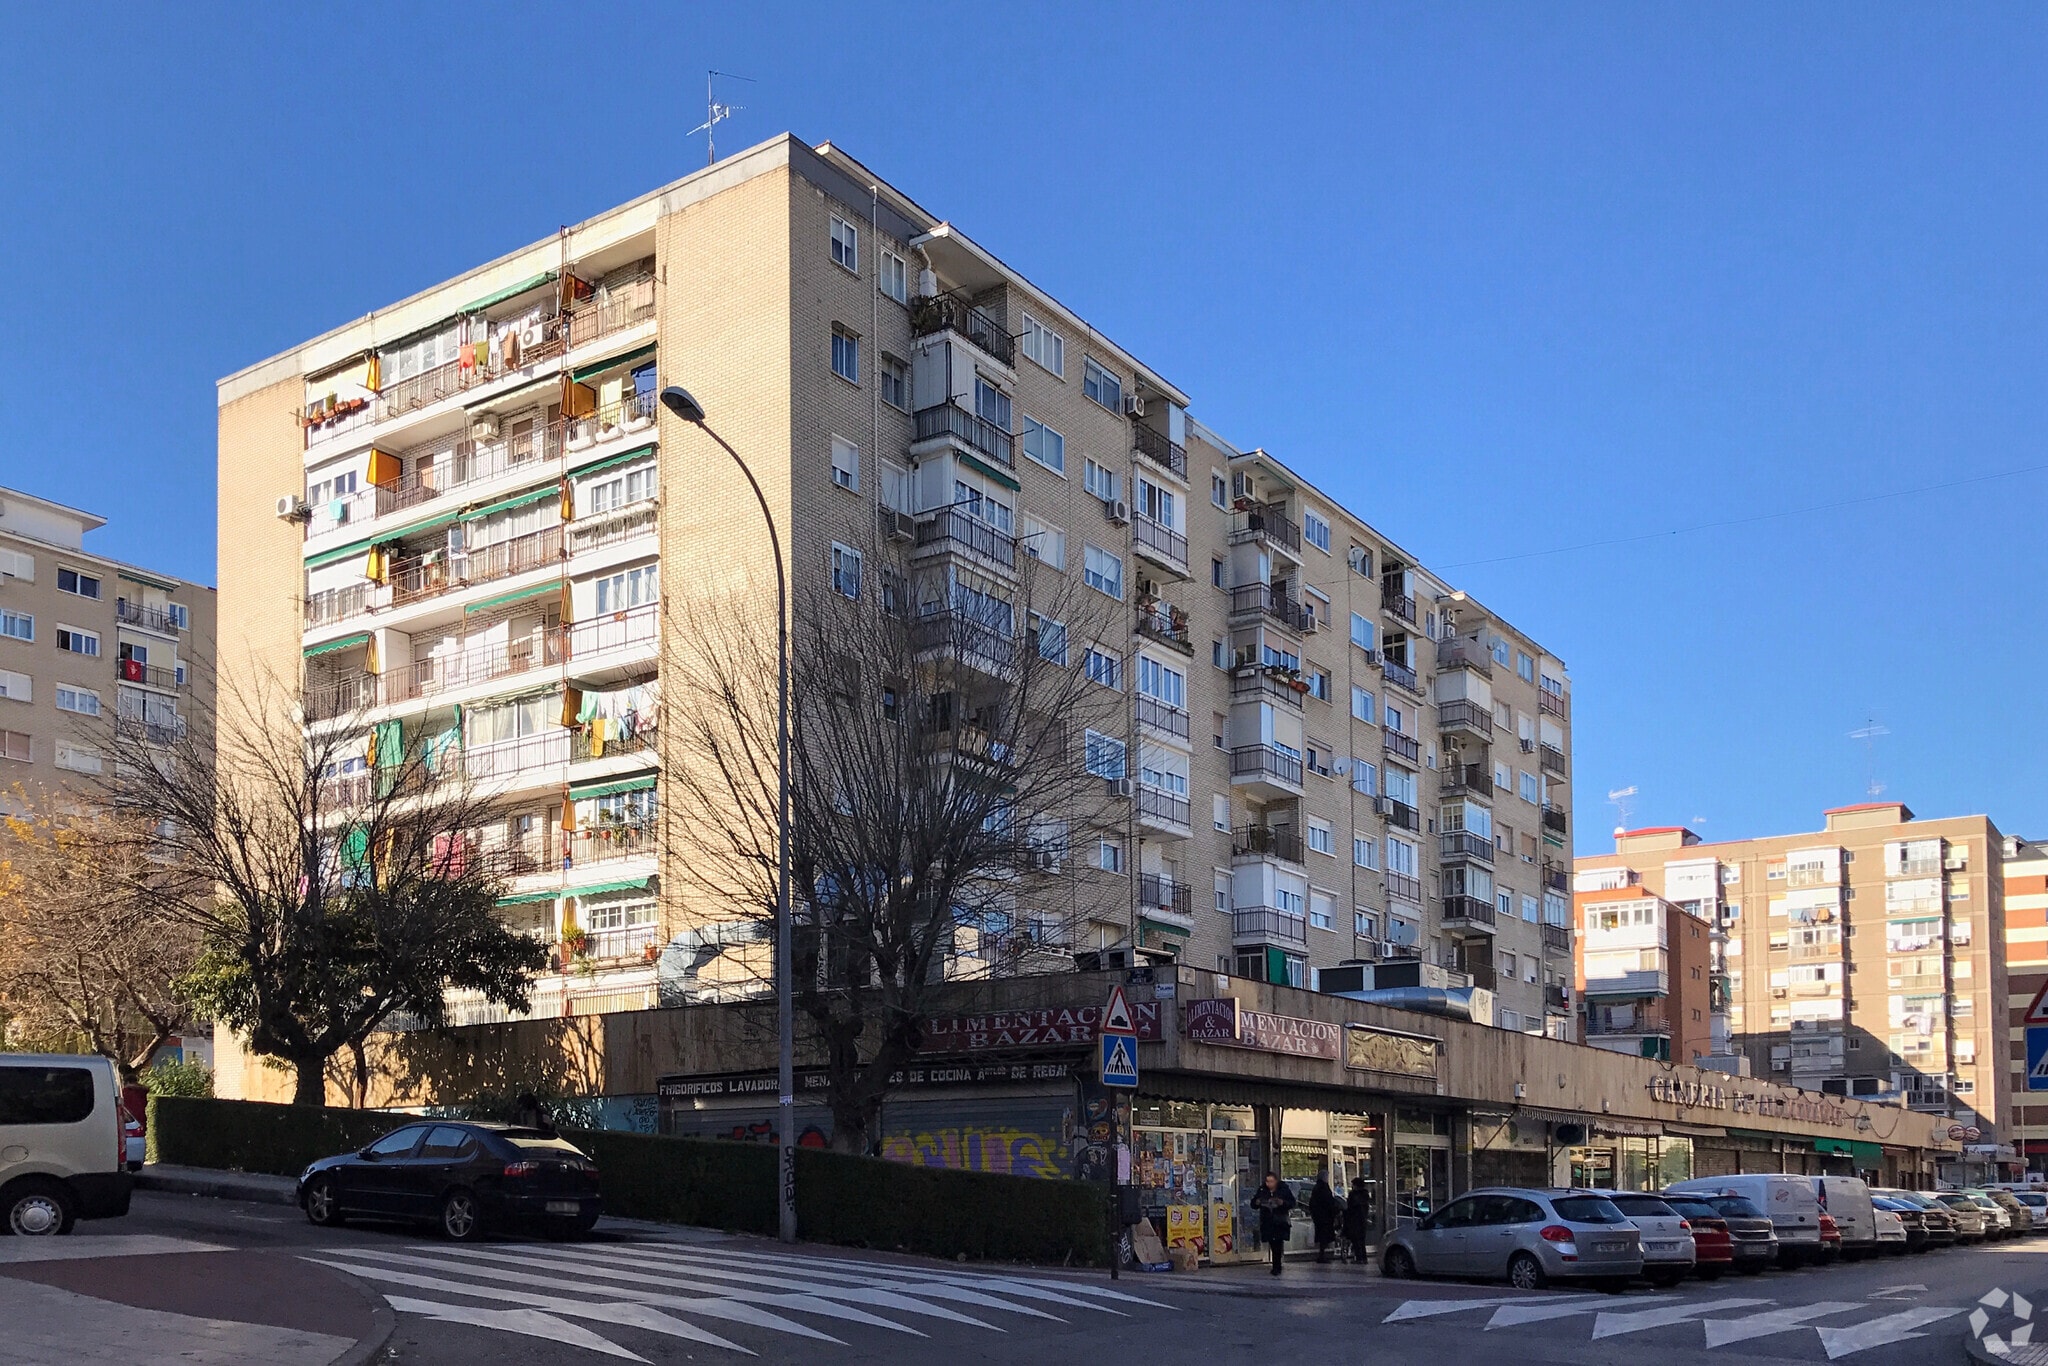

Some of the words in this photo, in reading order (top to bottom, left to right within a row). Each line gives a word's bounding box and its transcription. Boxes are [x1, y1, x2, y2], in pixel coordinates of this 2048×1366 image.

[930, 1002, 1158, 1036] LIMENTACN
[1188, 1000, 1234, 1026] ALIMENTACION
[1204, 1015, 1216, 1029] &
[968, 1025, 1094, 1049] BAZAR
[1191, 1028, 1230, 1039] BAZAR
[1240, 1011, 1338, 1041] MENTACION
[1241, 1029, 1309, 1054] BAZAR
[729, 1078, 781, 1093] LAVADOR
[910, 1070, 924, 1083] DE
[930, 1069, 972, 1082] COCINA
[1011, 1066, 1027, 1079] DE
